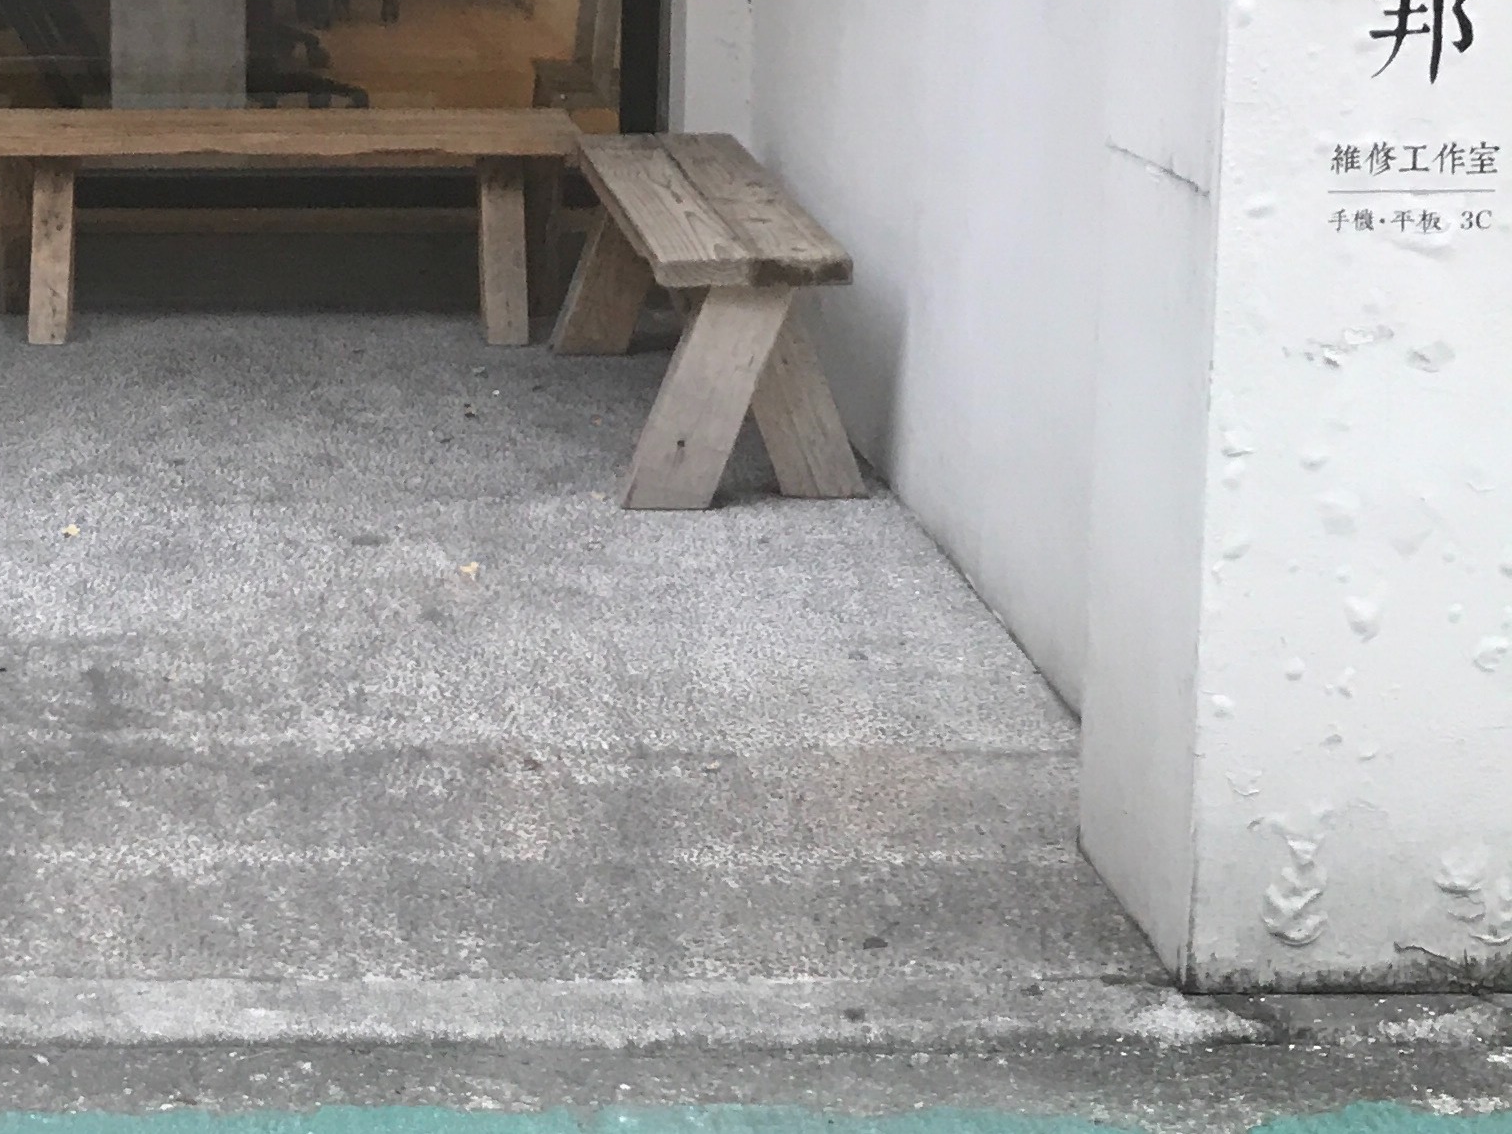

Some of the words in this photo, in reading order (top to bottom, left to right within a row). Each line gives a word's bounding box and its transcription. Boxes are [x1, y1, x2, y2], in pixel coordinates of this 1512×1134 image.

[1330, 142, 1500, 176] 維修工作室
[1460, 211, 1493, 233] 3C
